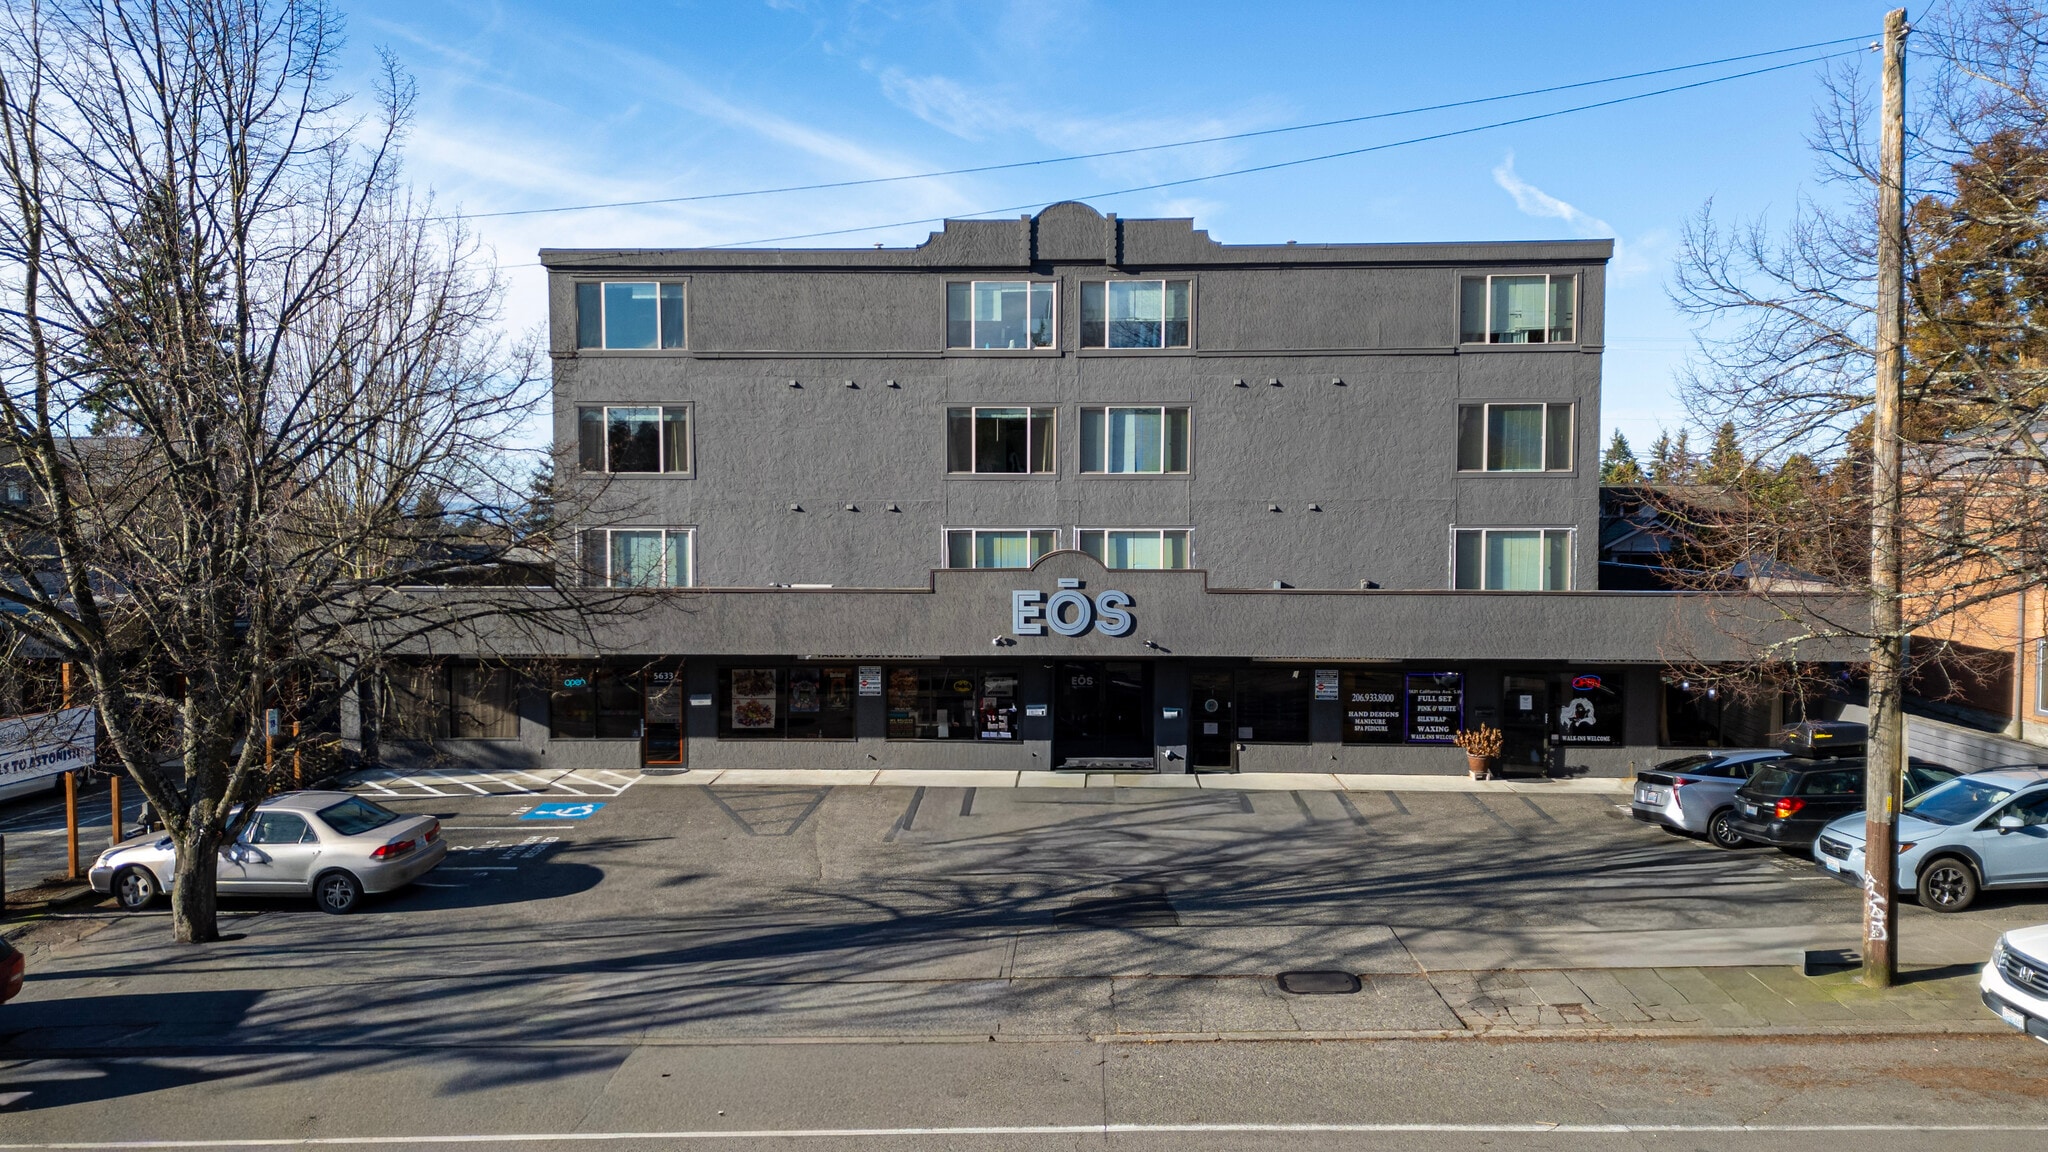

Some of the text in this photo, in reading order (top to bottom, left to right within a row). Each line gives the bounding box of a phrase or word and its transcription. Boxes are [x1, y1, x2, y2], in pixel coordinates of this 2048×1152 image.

[653, 672, 674, 680] 5633
[563, 677, 587, 687] open
[11, 759, 27, 772] TO
